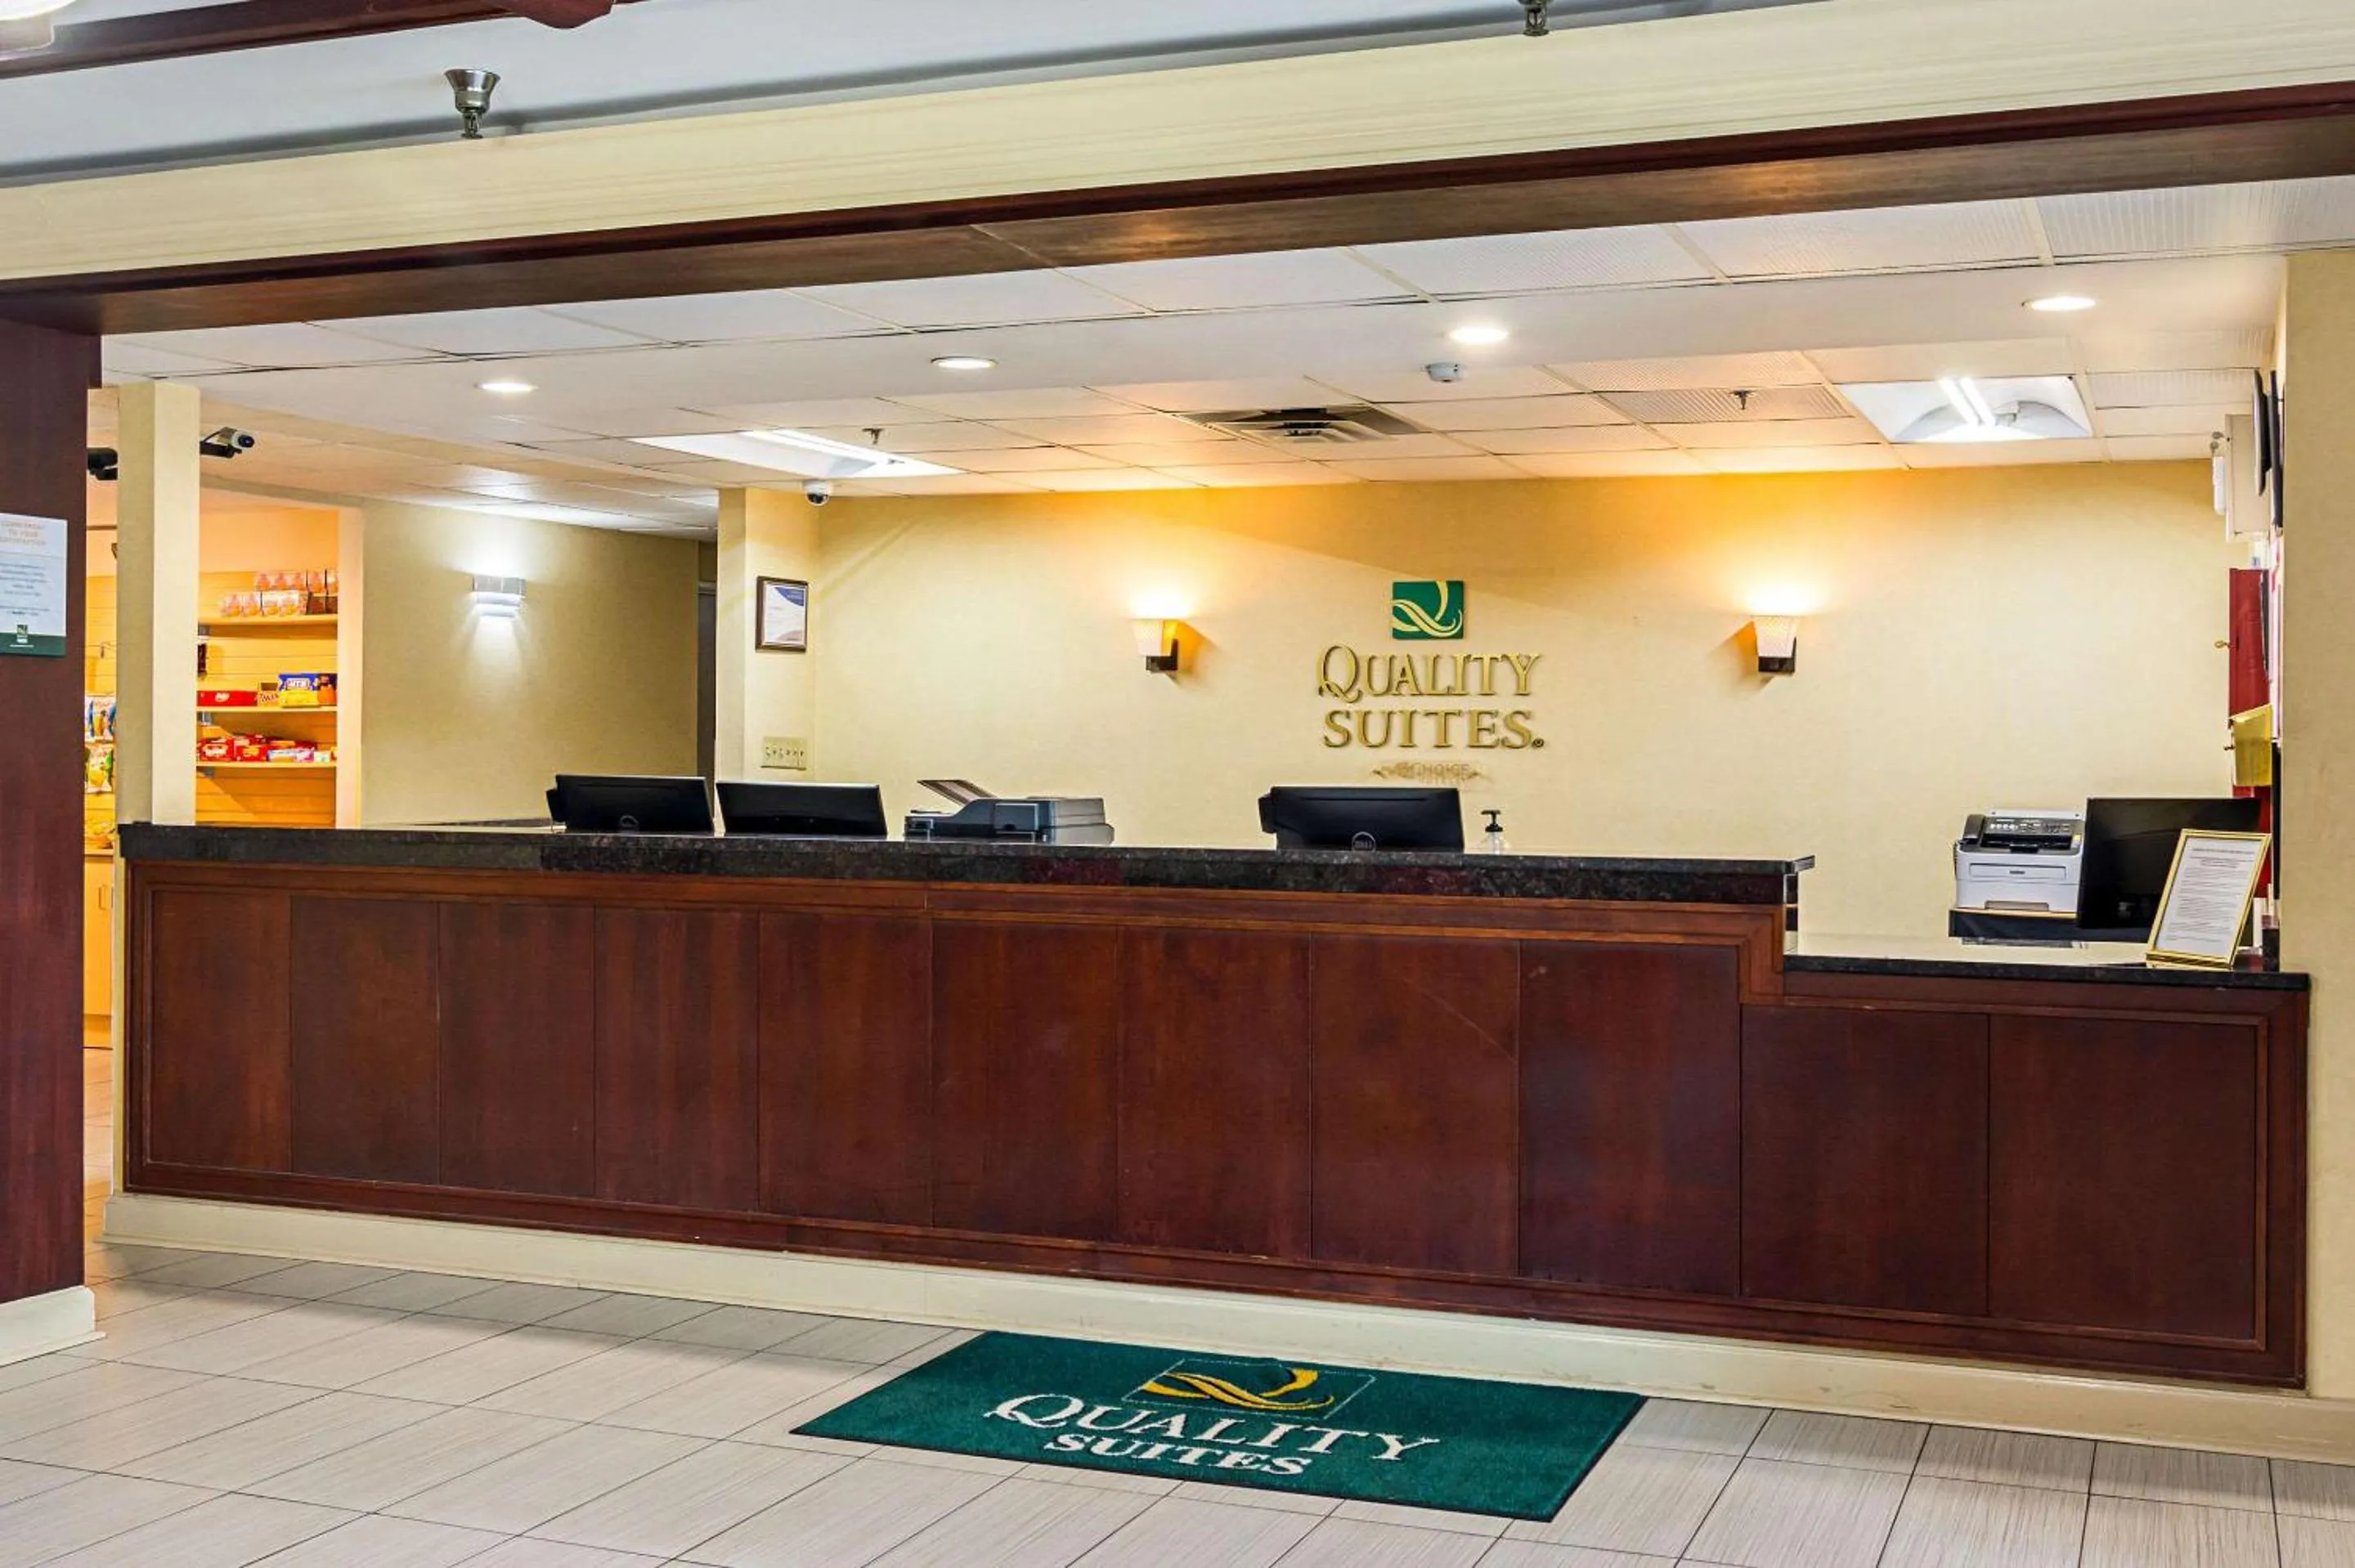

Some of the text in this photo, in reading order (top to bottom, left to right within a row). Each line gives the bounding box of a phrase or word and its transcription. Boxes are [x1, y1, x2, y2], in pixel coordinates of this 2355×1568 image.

[1317, 644, 1541, 703] QUALITY
[983, 1393, 1441, 1461] QUALITY
[1043, 1433, 1312, 1475] SUITES
